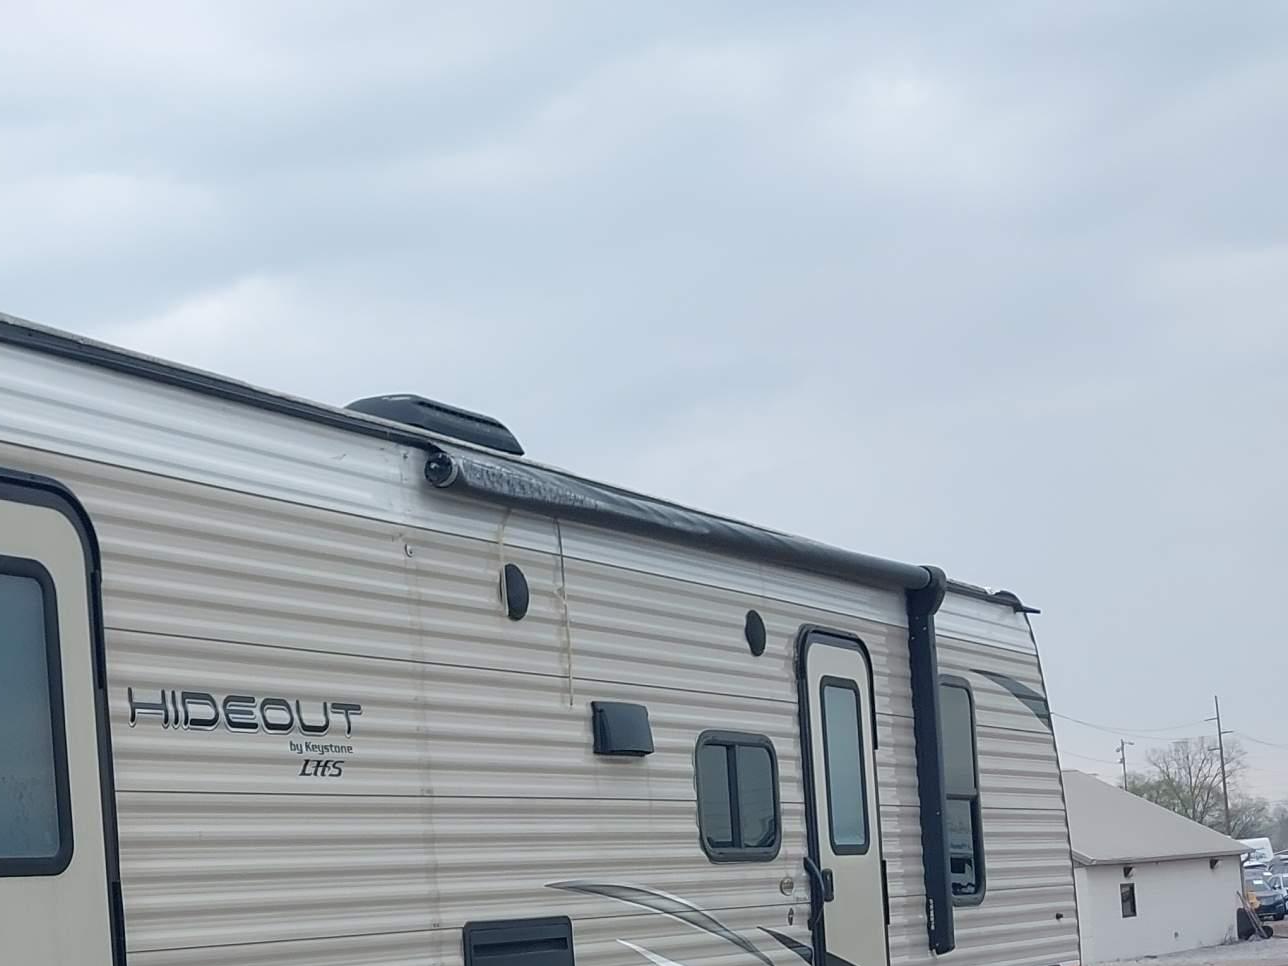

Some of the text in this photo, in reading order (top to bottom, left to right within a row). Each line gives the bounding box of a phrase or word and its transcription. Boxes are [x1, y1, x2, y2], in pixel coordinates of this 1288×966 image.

[127, 687, 363, 738] HIDEOUT
[289, 741, 354, 755] by Keystone
